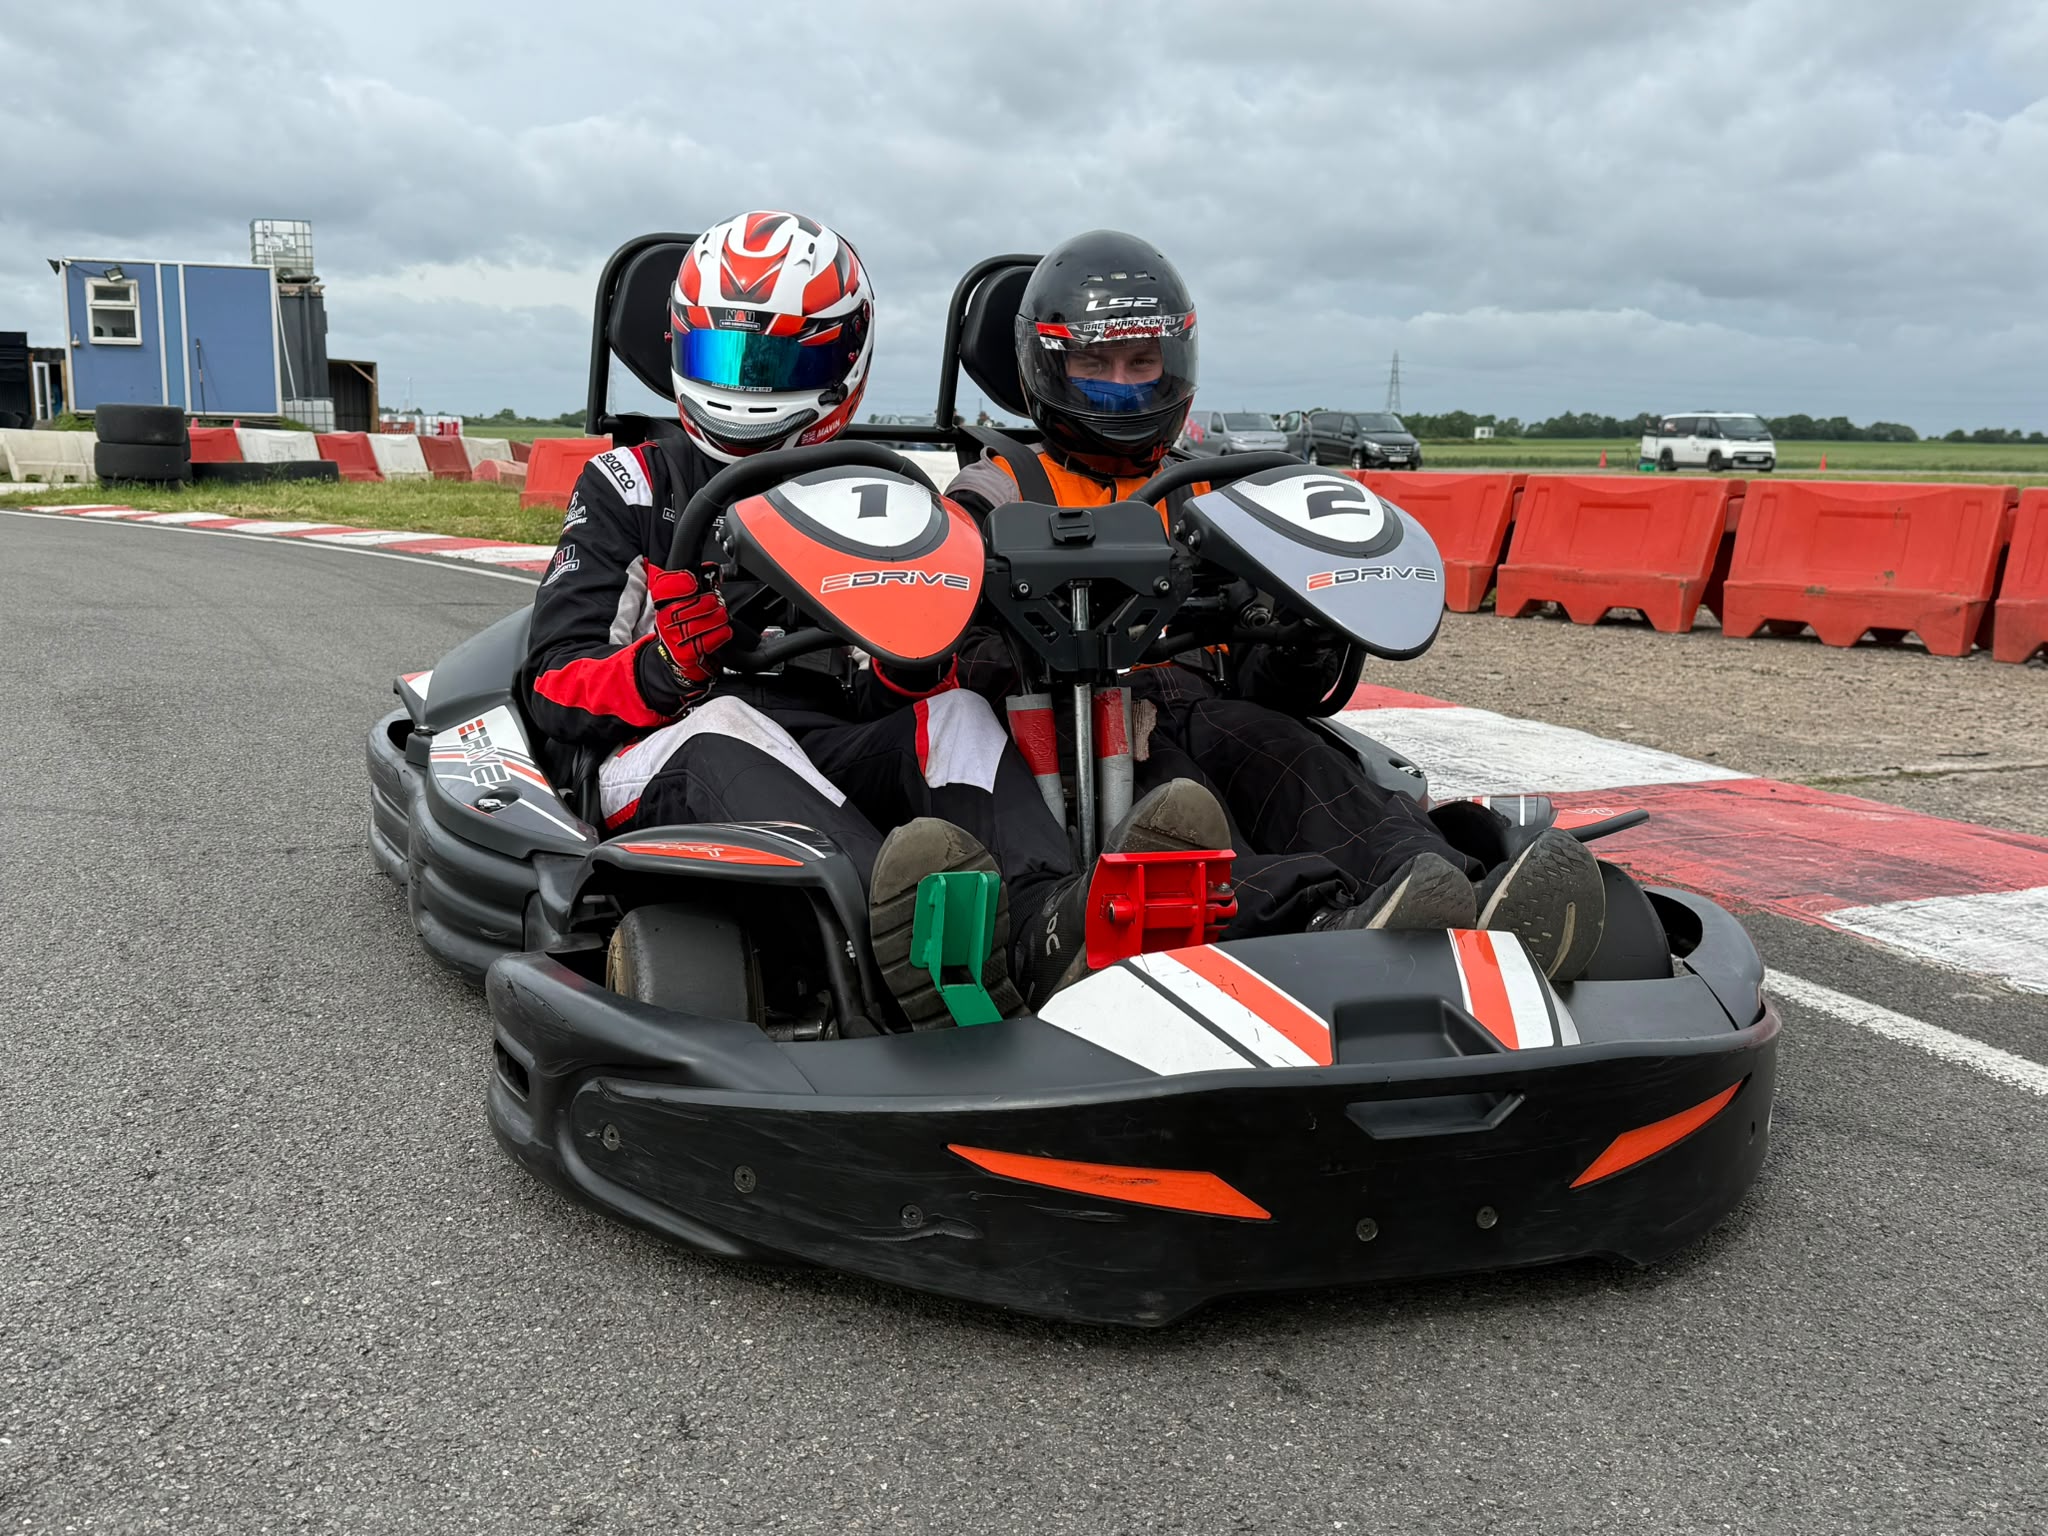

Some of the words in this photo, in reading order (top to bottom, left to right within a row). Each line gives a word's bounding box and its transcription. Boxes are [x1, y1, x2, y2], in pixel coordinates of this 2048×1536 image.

[1085, 296, 1158, 312] LS2
[851, 483, 889, 519] 1
[1303, 480, 1370, 520] 2
